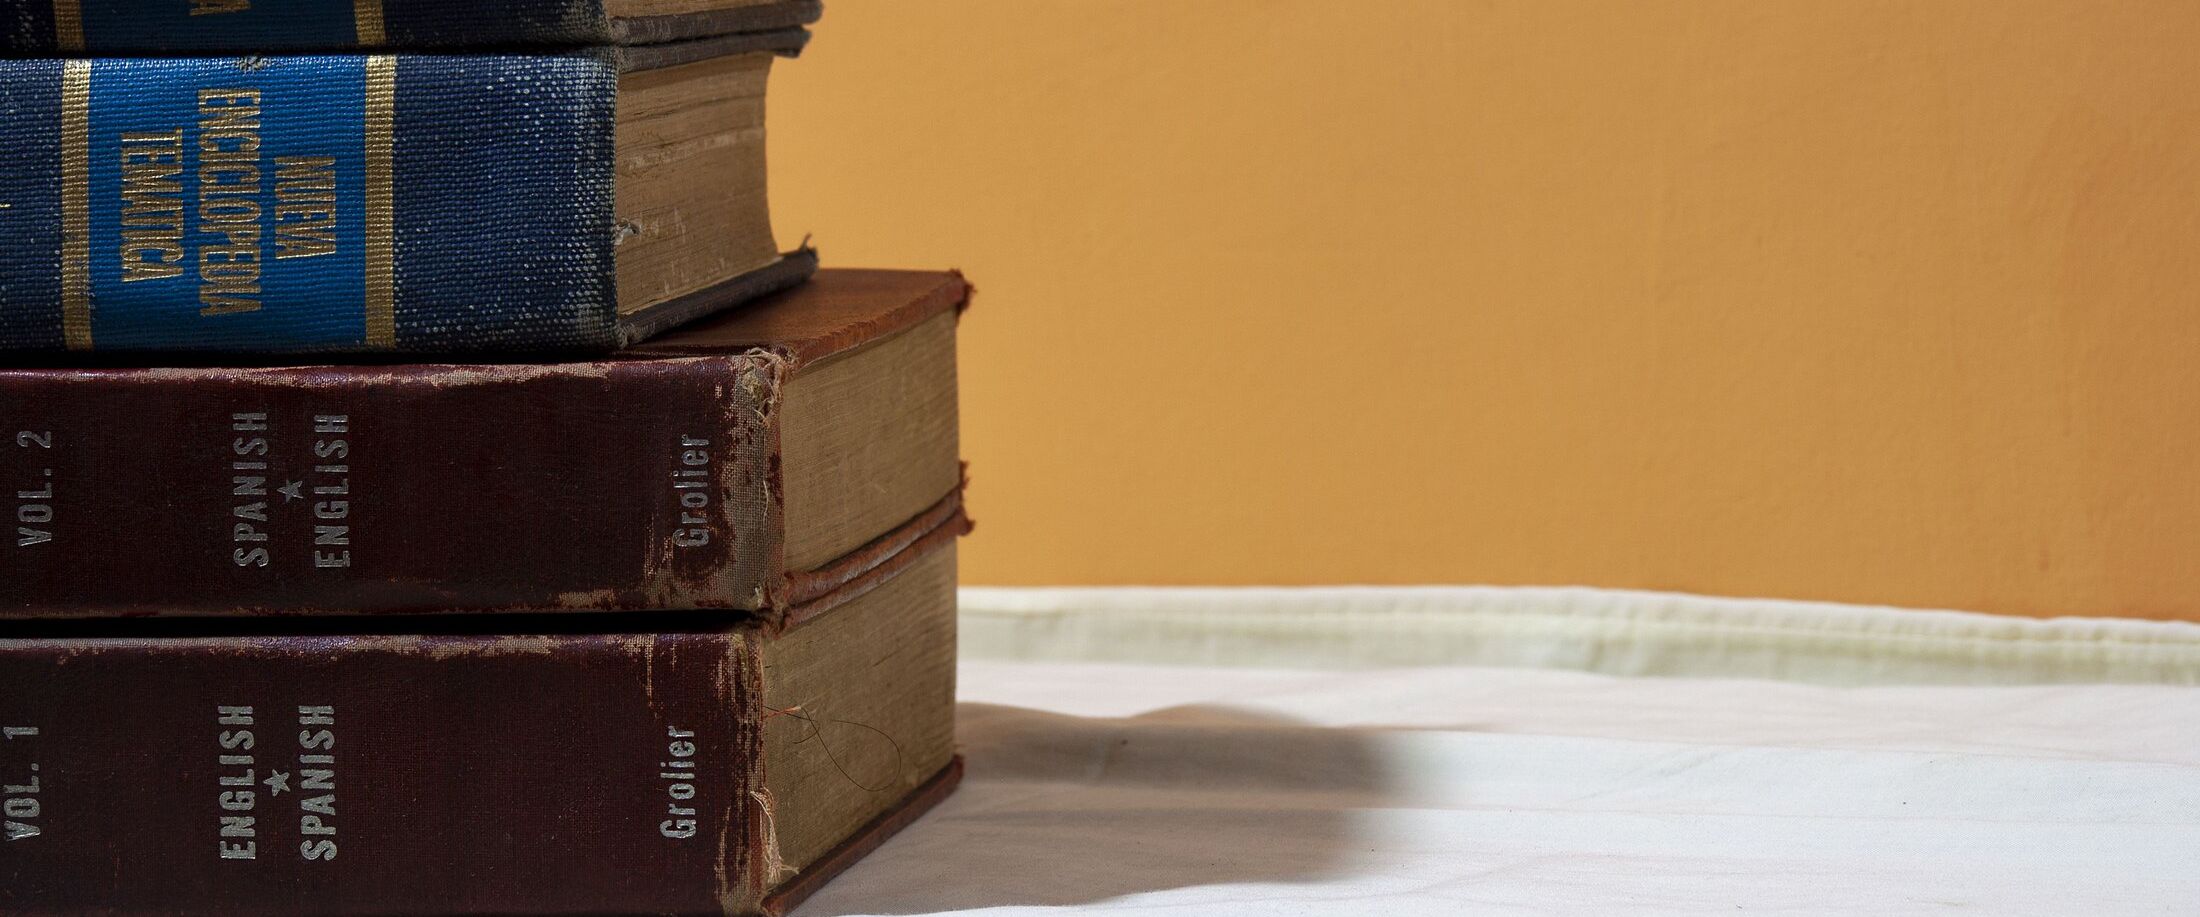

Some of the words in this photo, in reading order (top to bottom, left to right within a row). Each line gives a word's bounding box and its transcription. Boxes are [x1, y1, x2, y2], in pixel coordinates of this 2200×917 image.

[119, 127, 184, 283] TEMATICA
[197, 87, 263, 317] ENCICLOPEDIA
[274, 156, 337, 260] NUEVA
[16, 430, 51, 449] 2
[232, 412, 269, 567] SPANISH
[313, 414, 350, 568] ENGLISH
[672, 434, 710, 547] Grolier
[17, 468, 53, 547] VOL.
[3, 726, 40, 740] 1
[217, 705, 256, 860] ENGLISH
[298, 705, 338, 861] SPANISH
[660, 725, 697, 839] Grolier
[3, 762, 41, 841] VOL.
